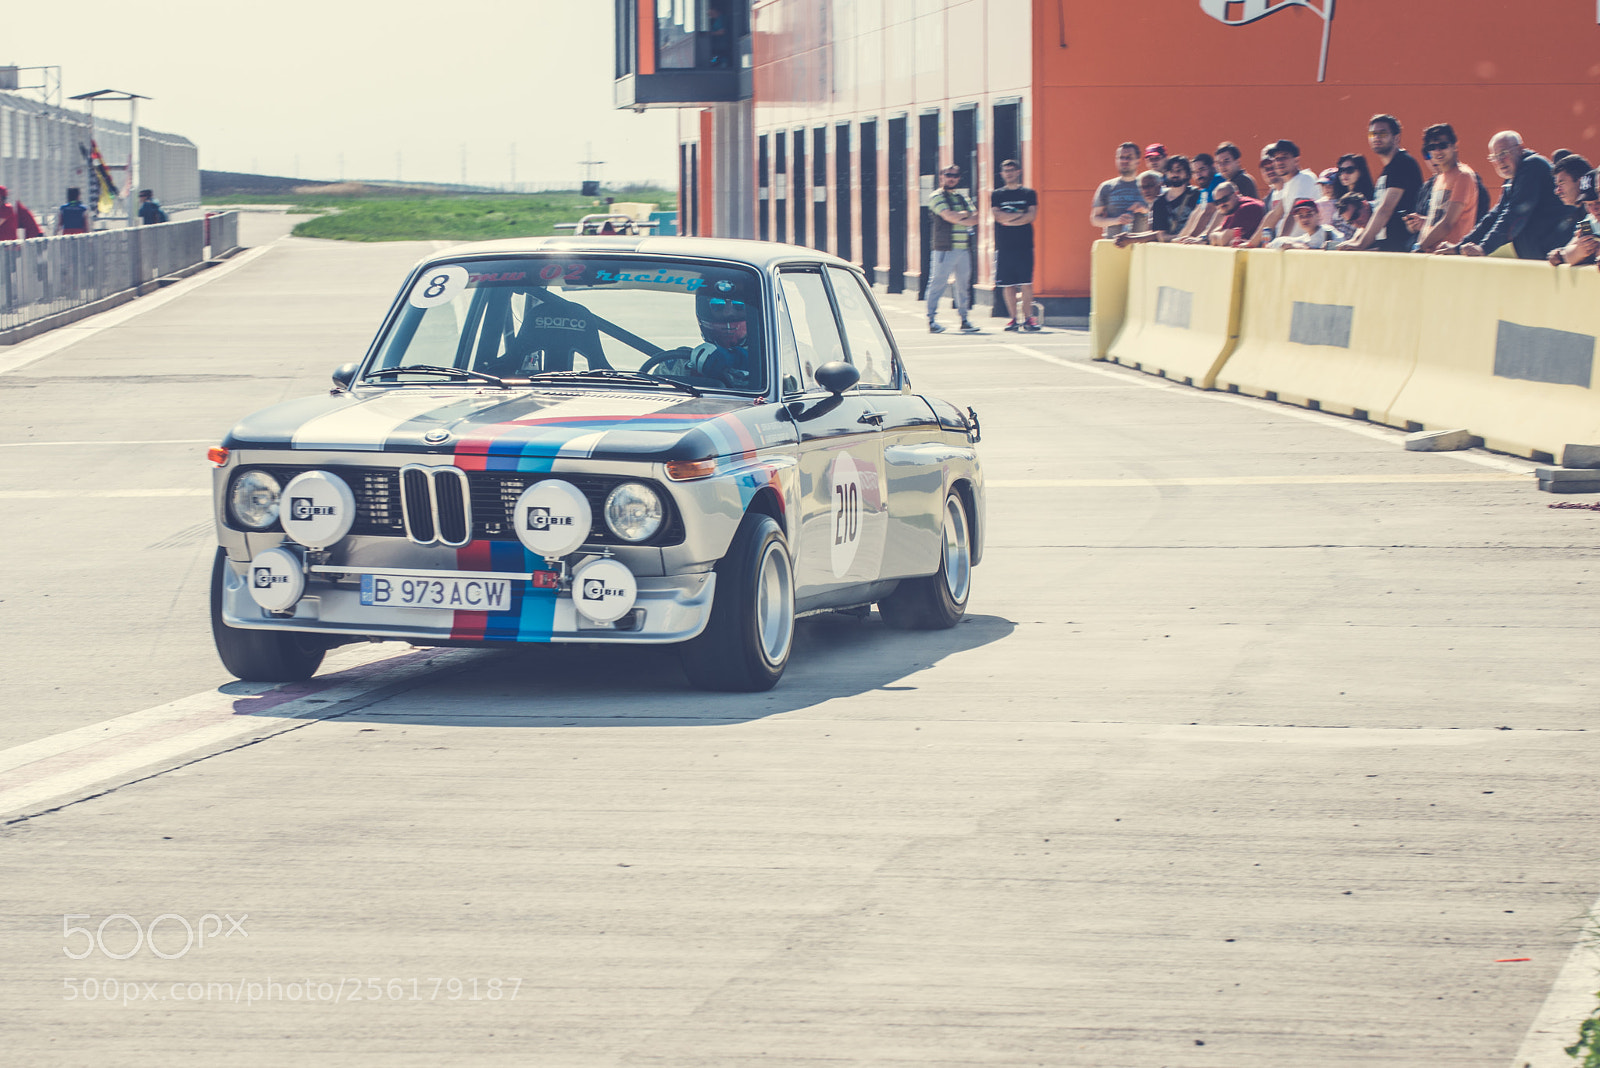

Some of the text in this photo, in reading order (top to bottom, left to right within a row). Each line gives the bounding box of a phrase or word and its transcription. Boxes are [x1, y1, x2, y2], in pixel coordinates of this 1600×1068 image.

[423, 273, 450, 299] 8
[468, 263, 708, 290] mw 02 racing
[535, 315, 587, 331] sparco
[834, 481, 858, 546] 210
[374, 578, 505, 607] B 973 ACW
